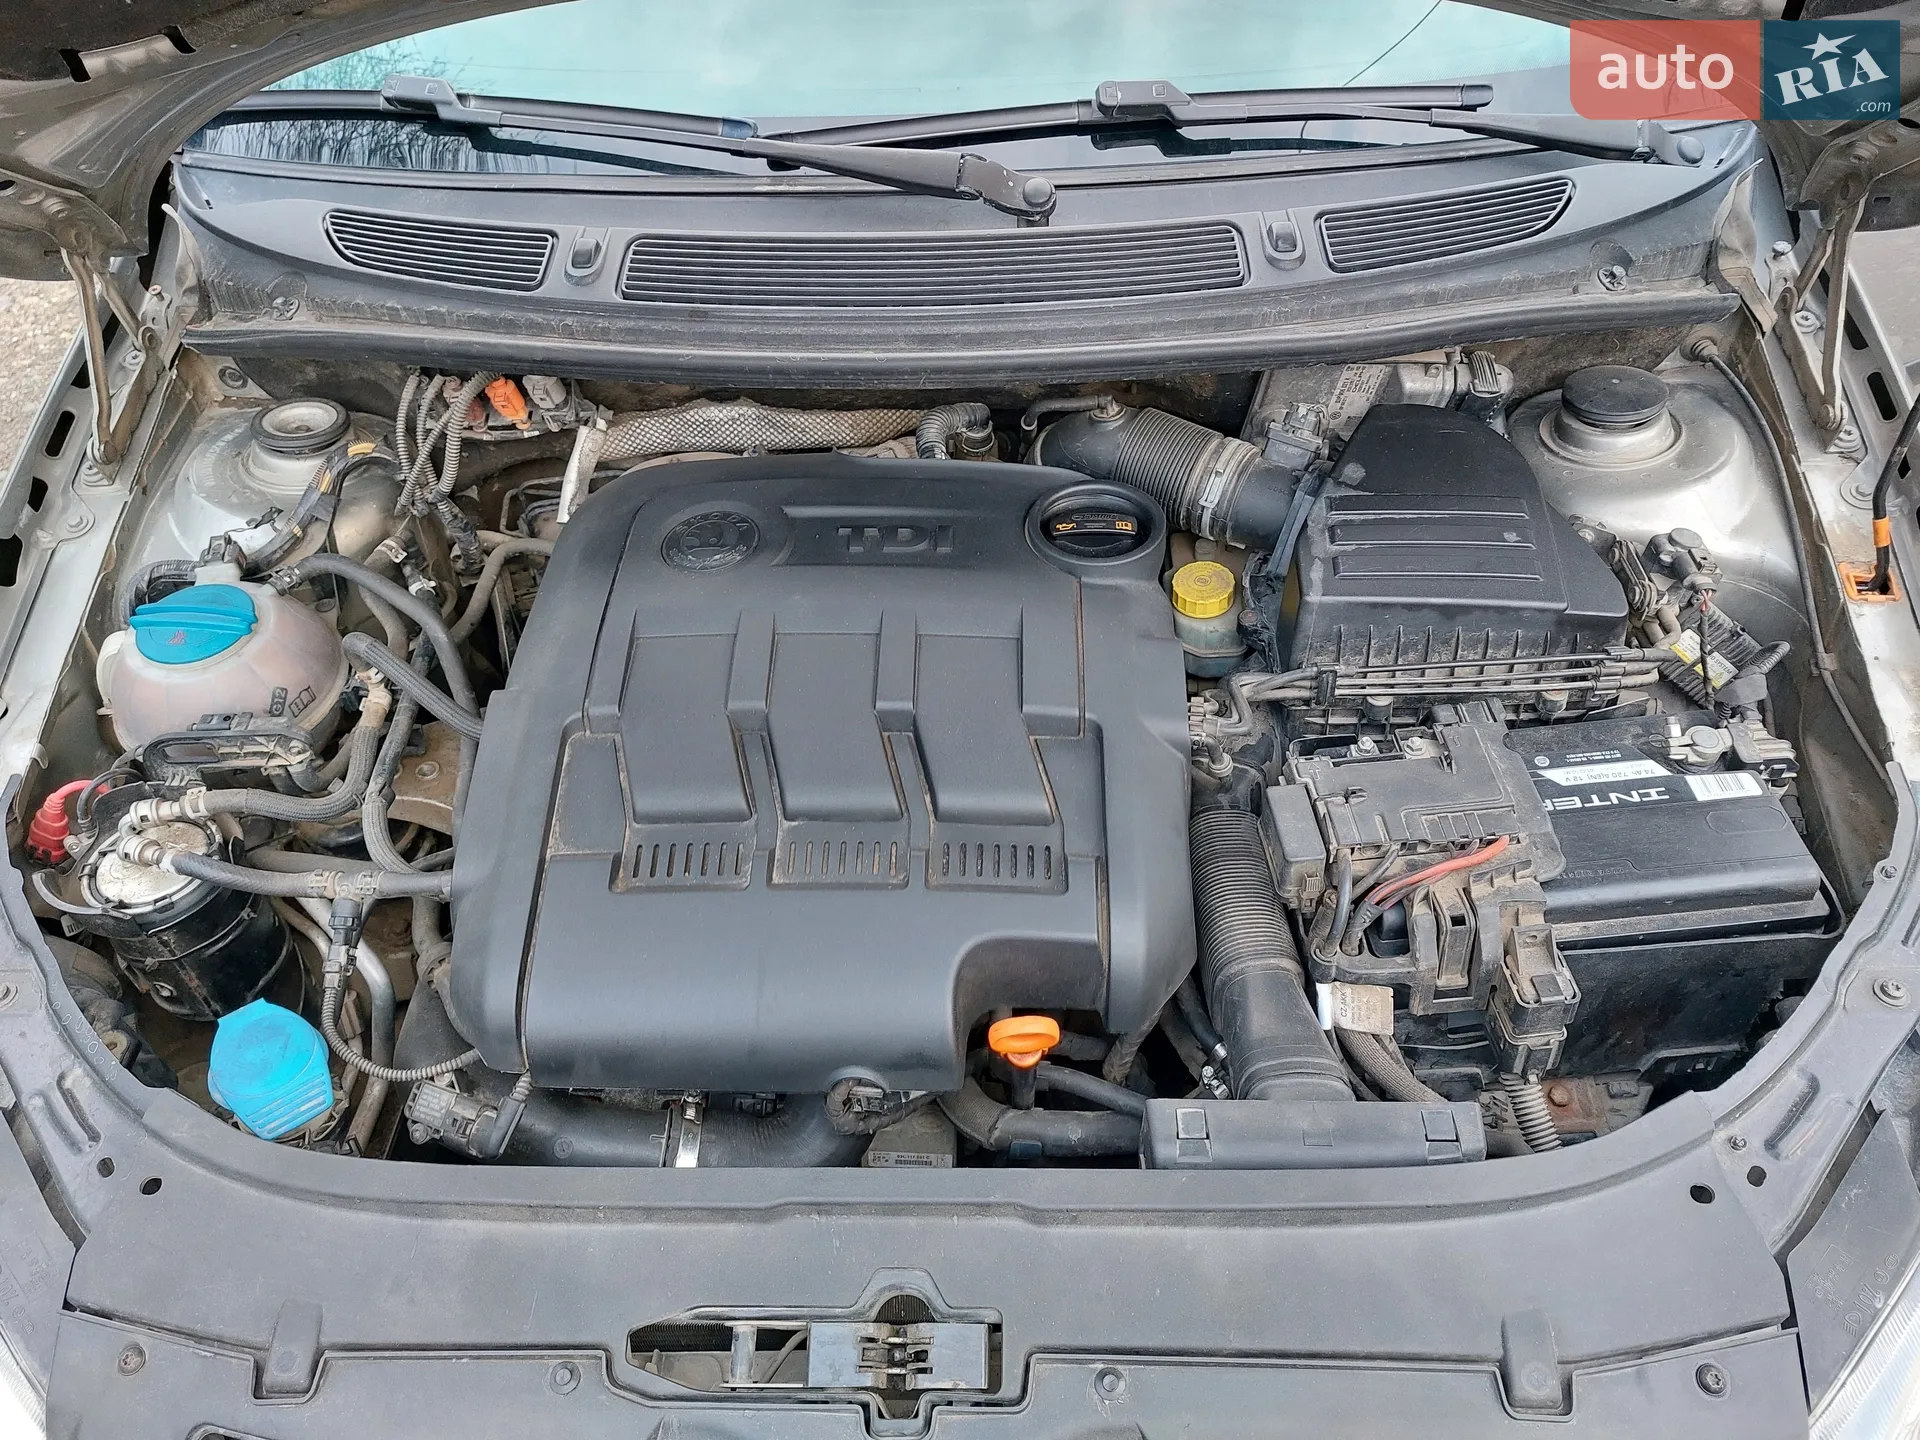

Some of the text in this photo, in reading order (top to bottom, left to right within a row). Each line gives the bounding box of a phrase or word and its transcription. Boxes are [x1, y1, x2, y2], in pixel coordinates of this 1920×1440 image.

[837, 525, 956, 554] TDI
[272, 689, 286, 714] G12
[1853, 1282, 1882, 1315] 10%
